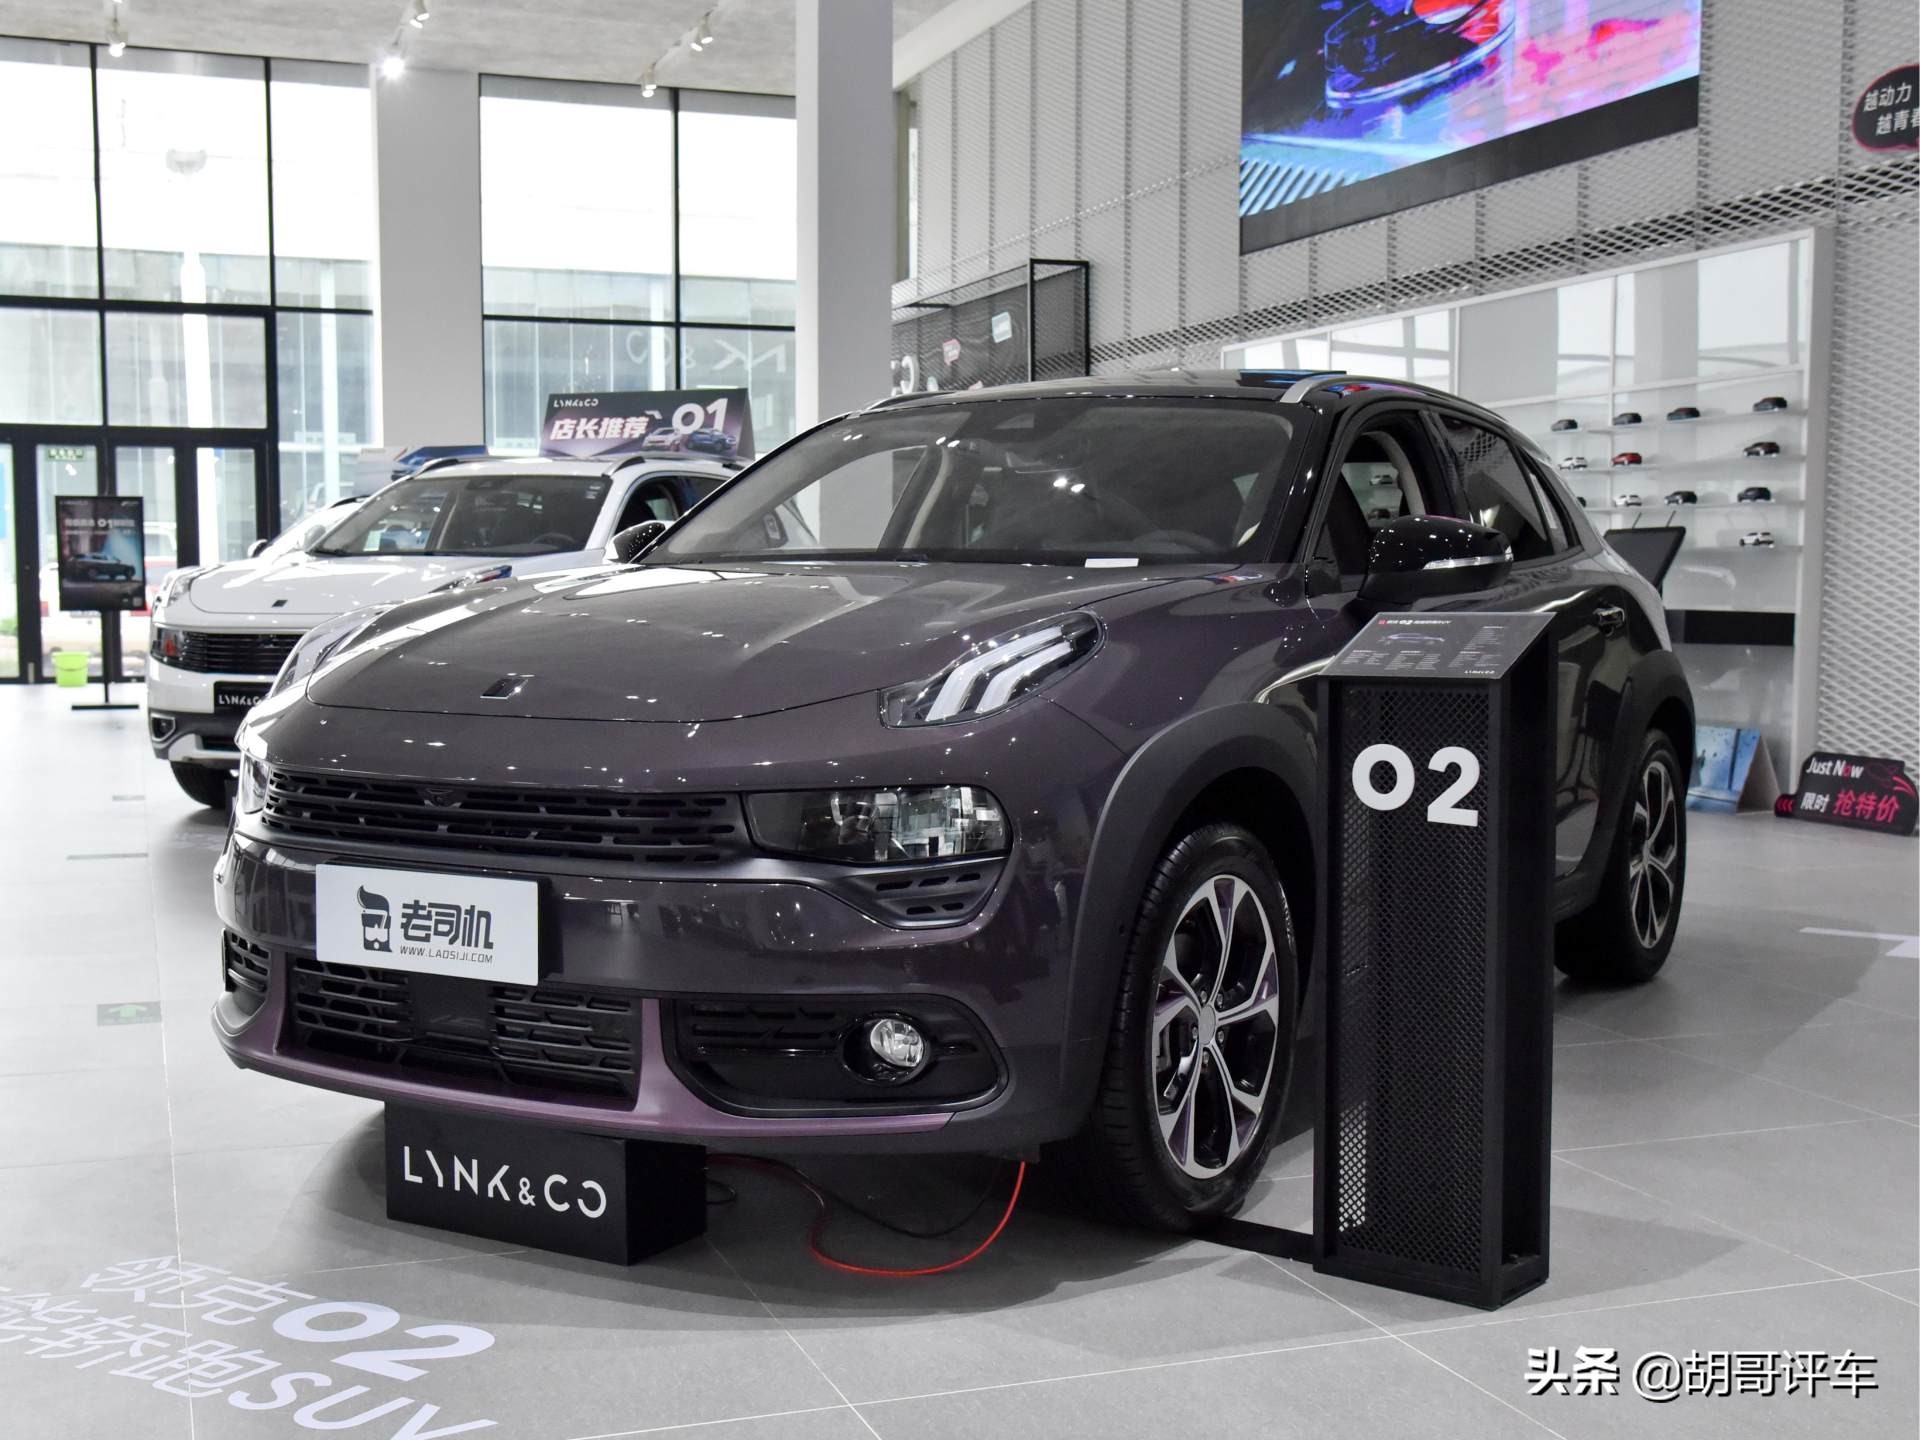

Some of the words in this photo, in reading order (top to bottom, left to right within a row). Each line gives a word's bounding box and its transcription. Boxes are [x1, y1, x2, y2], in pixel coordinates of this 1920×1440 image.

[550, 416, 649, 441] 店长推荐
[672, 398, 728, 434] 01
[218, 694, 264, 706] LYNK&C
[1351, 743, 1481, 828] 02
[1806, 757, 1833, 775] Just
[1832, 759, 1864, 779] Now
[1800, 791, 1830, 813] 限时
[1832, 788, 1900, 824] 抢特价
[401, 899, 494, 950] 老司机
[400, 945, 493, 964] WWW.LAOSIJI.COM
[404, 1145, 607, 1219] LYNK&CO
